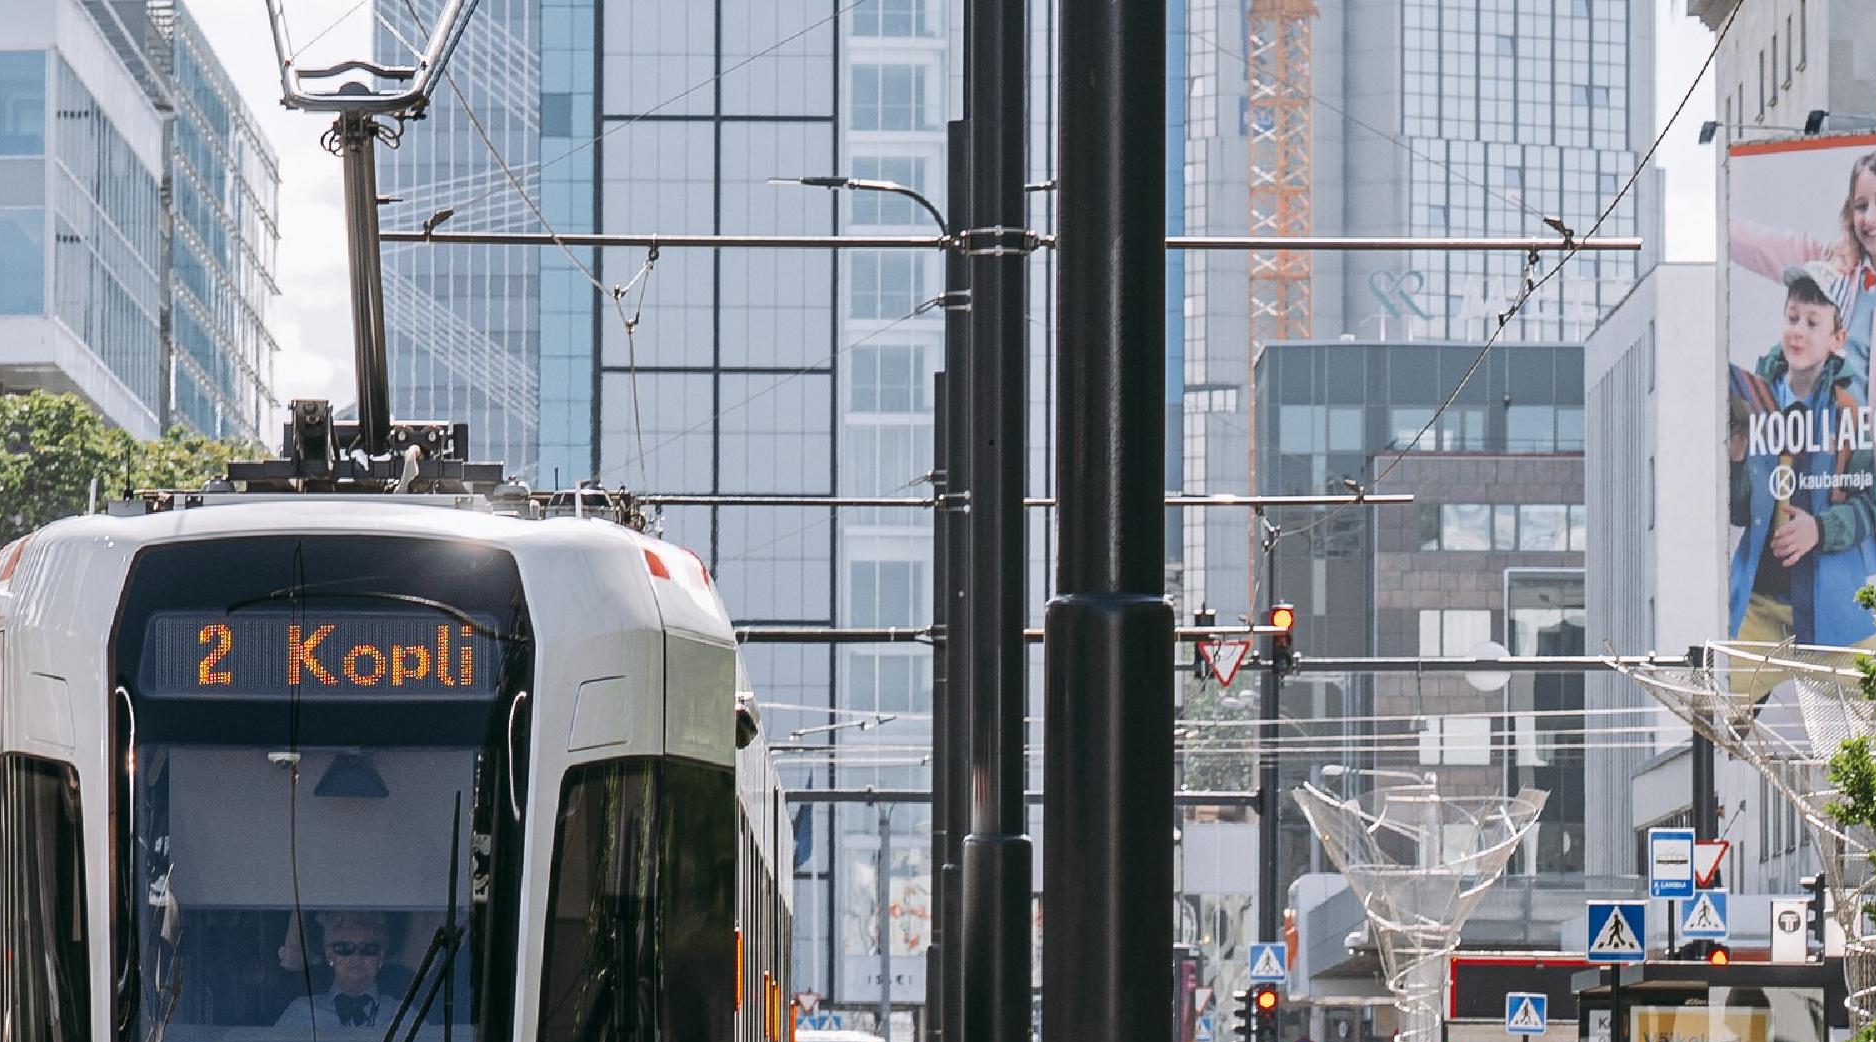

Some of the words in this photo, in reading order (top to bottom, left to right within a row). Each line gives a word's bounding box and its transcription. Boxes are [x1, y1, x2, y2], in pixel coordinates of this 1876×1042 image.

[1749, 409, 1830, 457] KOOLI
[1799, 470, 1873, 490] kaubamaja
[199, 624, 232, 686] 2
[289, 624, 473, 686] Kopli
